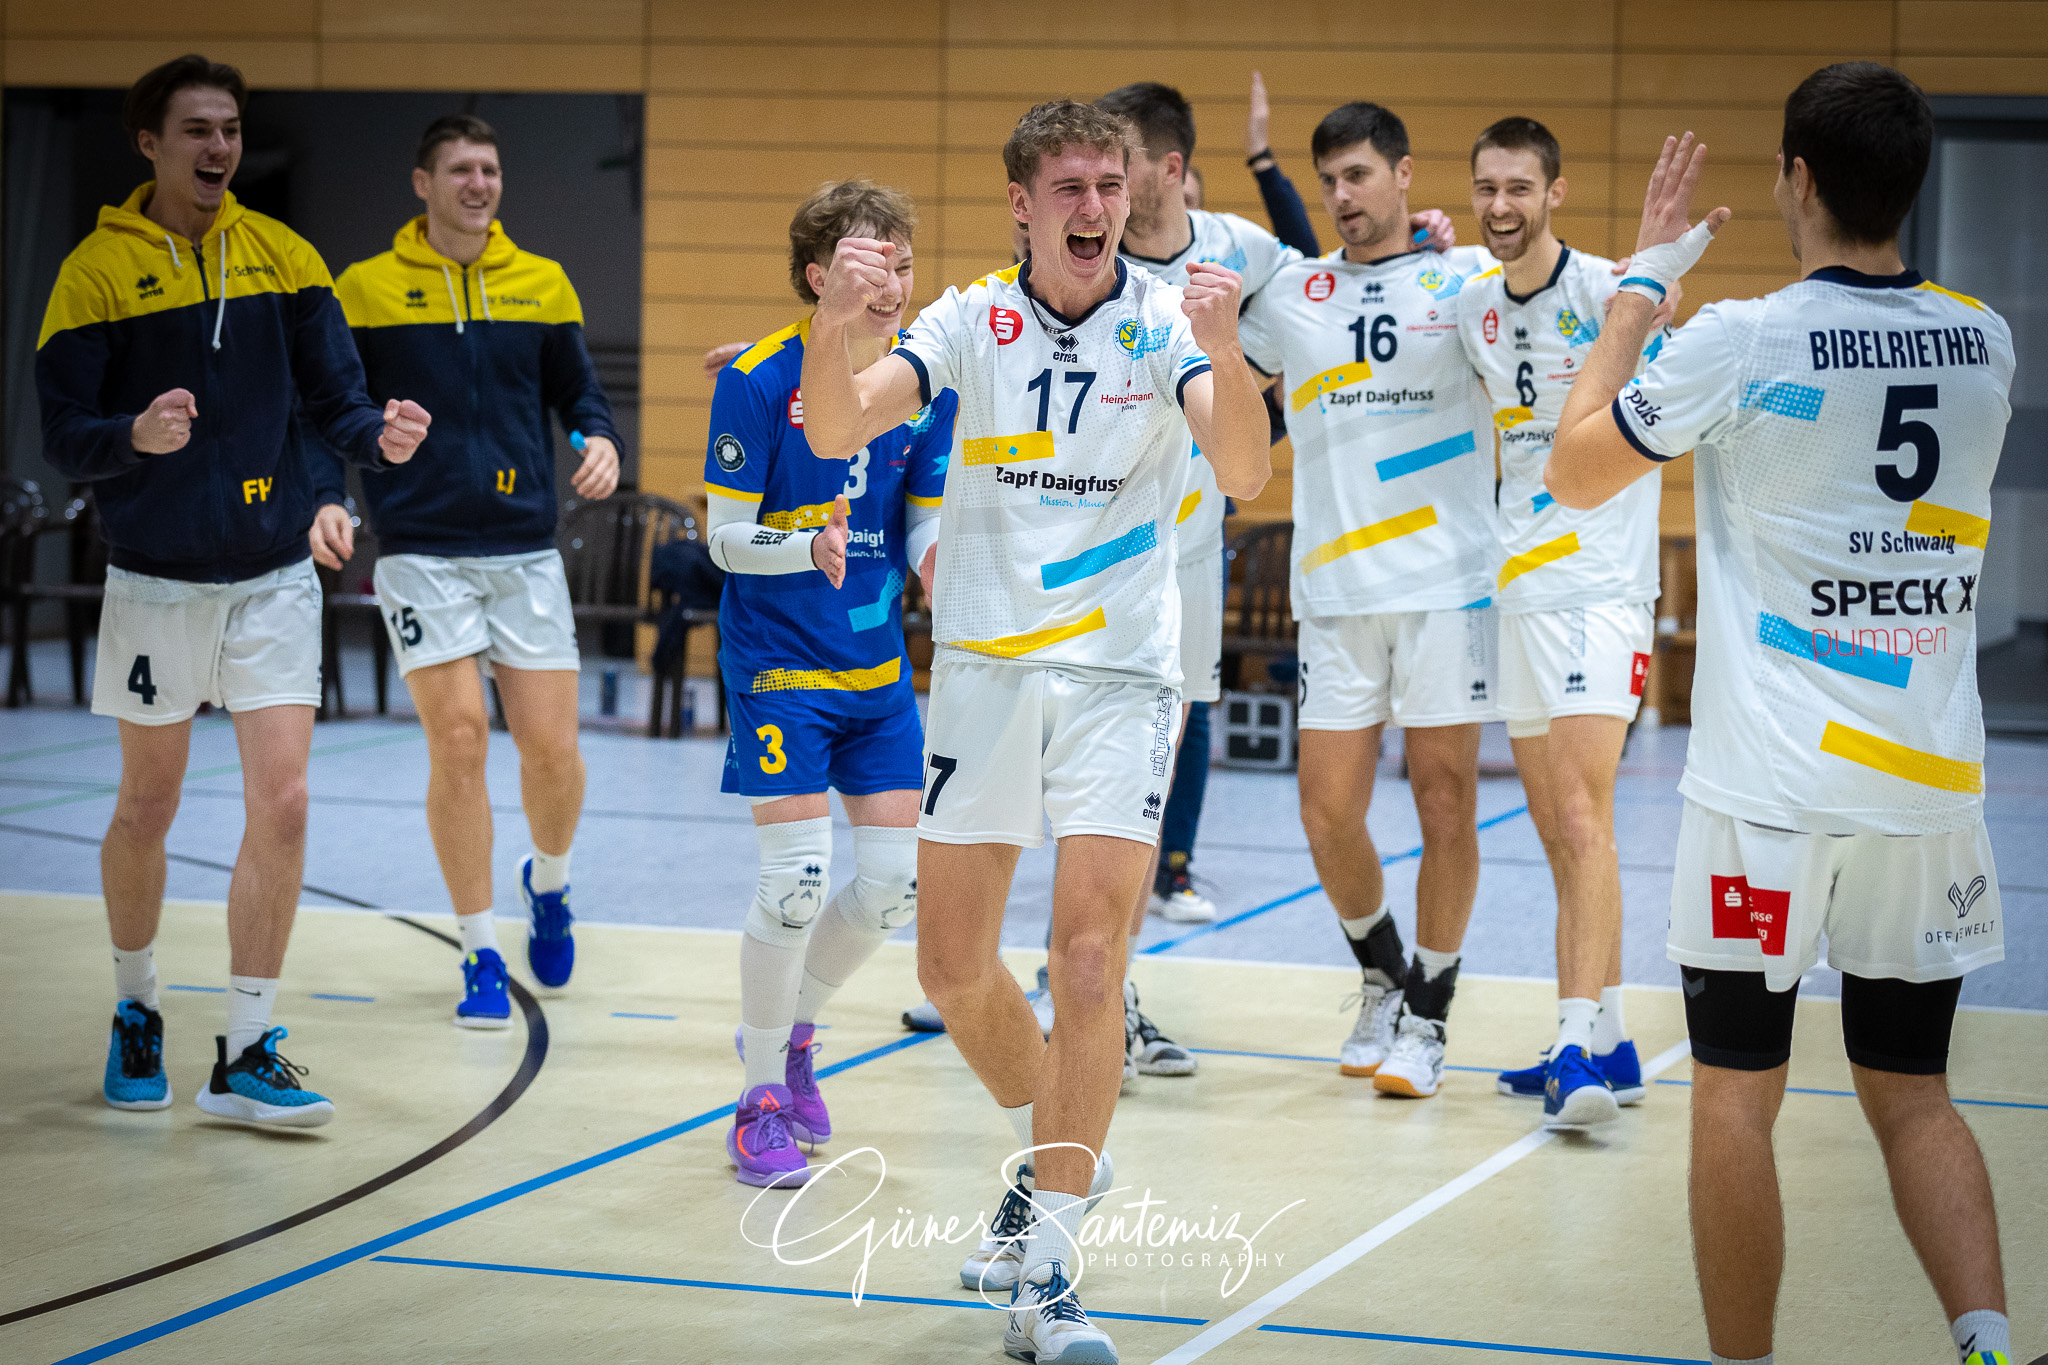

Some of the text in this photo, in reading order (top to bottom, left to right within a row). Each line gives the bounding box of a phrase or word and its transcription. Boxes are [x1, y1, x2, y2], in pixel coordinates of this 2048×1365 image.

[1349, 314, 1398, 363] 16
[1809, 326, 1990, 371] BIBELRIETHER
[1027, 368, 1098, 434] 17
[1329, 388, 1435, 406] Zapf Daigfuss
[1516, 361, 1537, 407] 6
[1874, 383, 1941, 503] 5
[843, 446, 871, 499] 3
[1849, 529, 1956, 555] SV Schwaig
[1811, 577, 1949, 617] SPECK
[1812, 626, 1947, 666] pumpen
[128, 654, 157, 706] 4
[756, 724, 787, 774] 3
